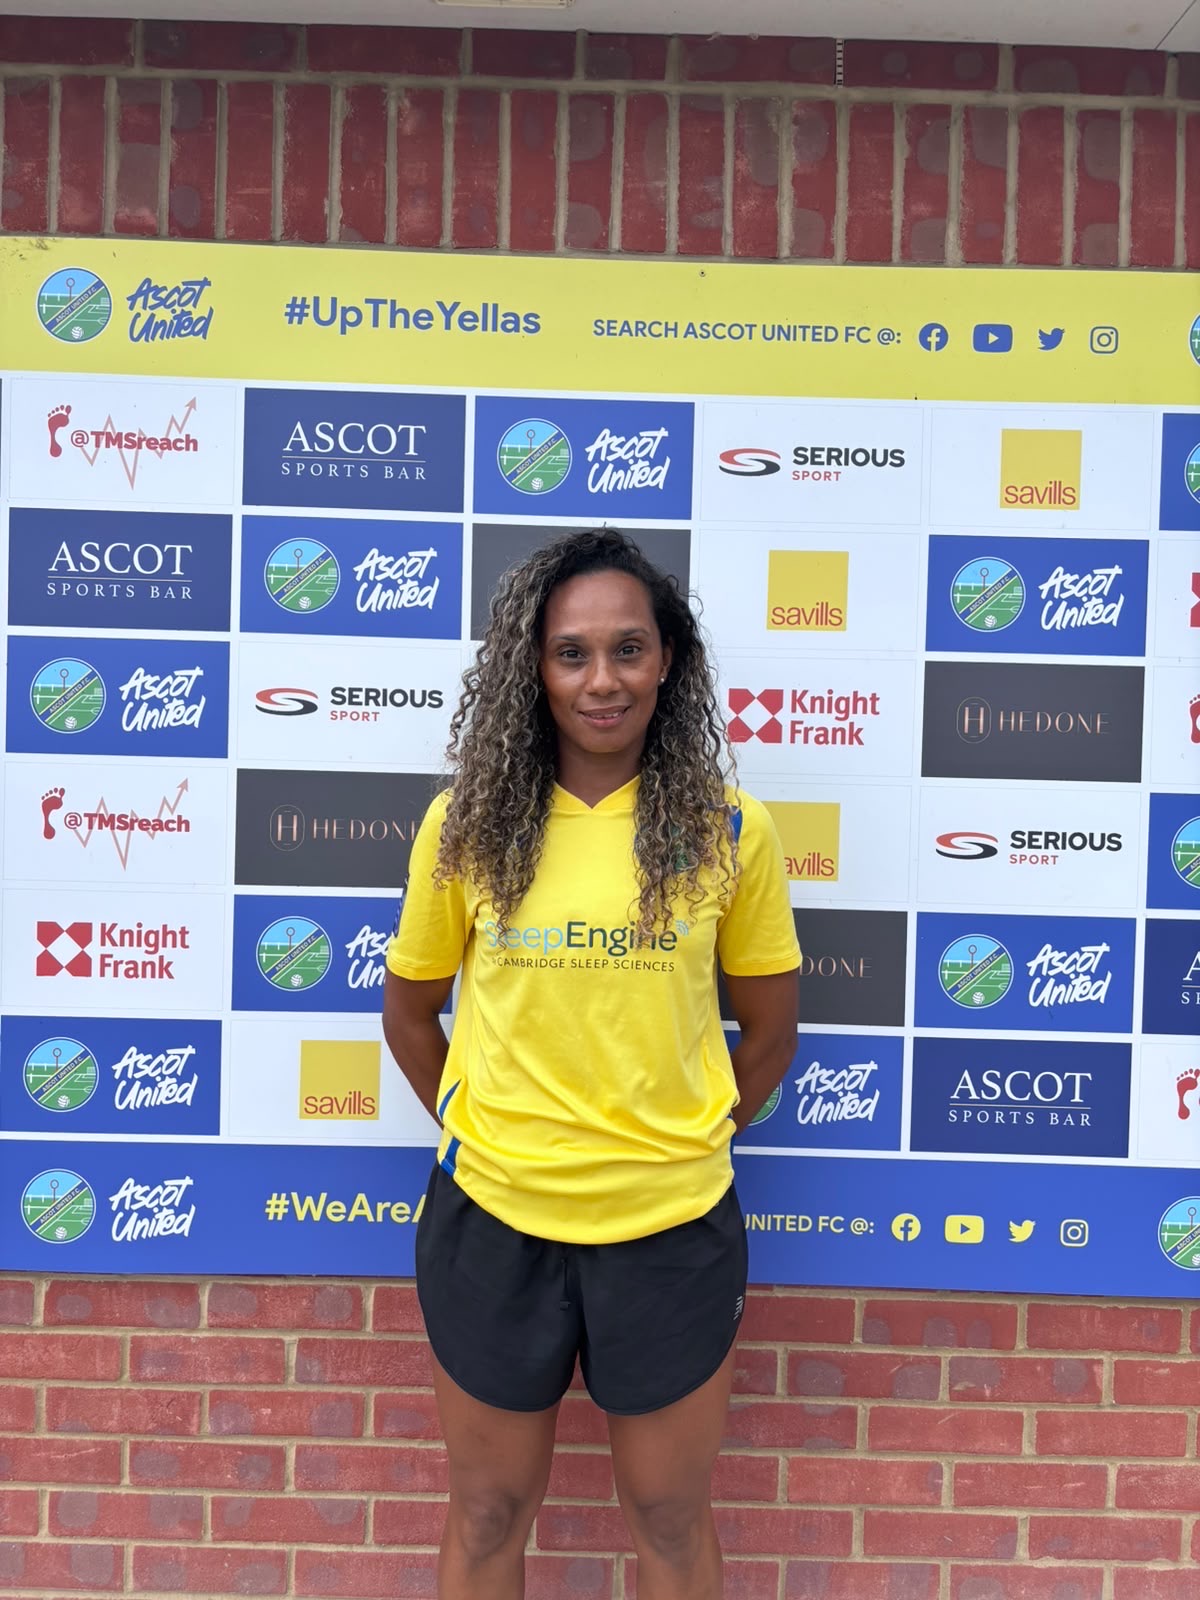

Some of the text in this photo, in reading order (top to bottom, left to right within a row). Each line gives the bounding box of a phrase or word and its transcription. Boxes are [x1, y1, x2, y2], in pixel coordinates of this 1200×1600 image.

[127, 278, 211, 311] Ascot
[129, 308, 214, 343] United
[285, 297, 541, 334] #UpTheYellas
[593, 319, 902, 345] SEARCH ASCOT UNITED FC @:
[71, 429, 198, 452] @TMSreach
[283, 421, 426, 457] ASCOT
[585, 427, 668, 461] Ascot
[282, 462, 426, 480] SPORTS BAR
[792, 447, 905, 468] SERIOUS
[587, 459, 670, 494] United
[792, 471, 841, 482] SPORT
[1005, 480, 1076, 506] savills
[49, 541, 193, 576] ASCOT
[353, 548, 438, 581] Ascot
[47, 582, 193, 599] SPORTS BAR
[355, 579, 439, 613] United
[1038, 565, 1123, 598] Ascot
[771, 602, 843, 627] savills
[1041, 596, 1124, 631] United
[119, 667, 204, 699] Ascot
[330, 687, 444, 709] SERIOUS
[122, 697, 207, 731] United
[330, 711, 380, 722] SPORT
[791, 689, 880, 720] Knight
[790, 720, 864, 746] Frank
[999, 710, 1109, 734] HEDONE
[64, 812, 190, 833] @TMSreach
[1010, 831, 1122, 852] SERIOUS
[784, 852, 835, 876] avills
[1009, 854, 1059, 865] SPORT
[100, 923, 189, 954] Knight
[484, 921, 677, 956] SeepEngie
[99, 954, 175, 980] Frank
[498, 957, 565, 968] CAMBRIDGE
[571, 958, 608, 968] SLEEP
[614, 959, 674, 972] SCIENCES
[800, 956, 872, 978] DONE
[1027, 943, 1109, 976] Ascot
[1029, 972, 1111, 1008] United
[112, 1046, 196, 1078] Ascot
[795, 1060, 878, 1094] Ascot
[114, 1076, 197, 1111] United
[951, 1069, 1092, 1103] ASCOT
[304, 1091, 375, 1115] savills
[797, 1088, 880, 1125] United
[949, 1110, 1092, 1127] SPORTS BAR
[109, 1175, 193, 1211] Ascot
[112, 1206, 196, 1242] United
[818, 1216, 844, 1233] FC
[850, 1217, 874, 1235] @:
